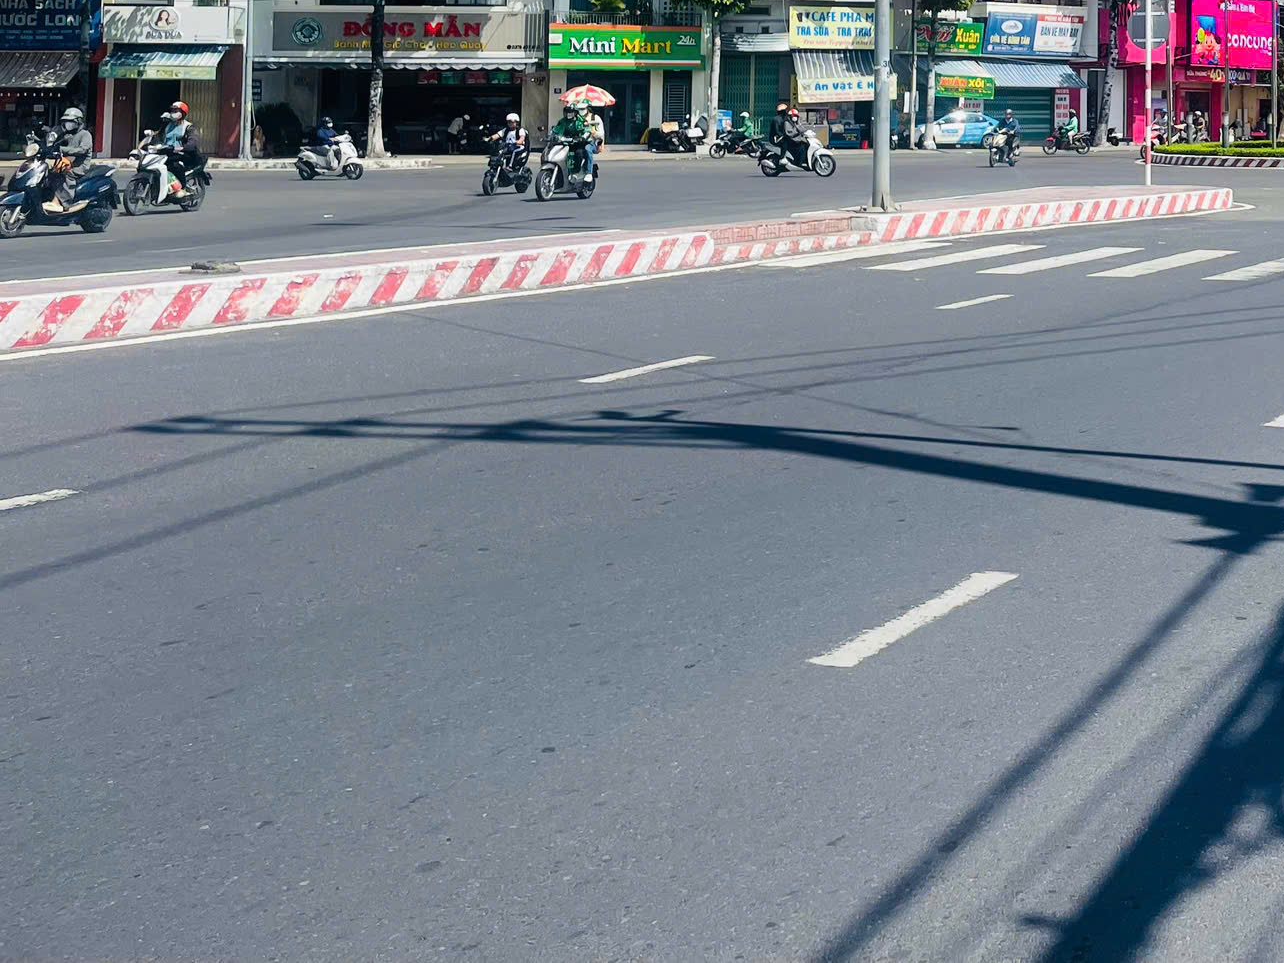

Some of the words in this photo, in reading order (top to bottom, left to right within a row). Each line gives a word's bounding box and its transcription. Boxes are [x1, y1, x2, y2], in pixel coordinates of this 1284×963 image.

[44, 14, 82, 26] LON
[840, 12, 862, 22] PHA
[677, 35, 696, 46] 24h
[956, 29, 980, 43] Xuân
[570, 36, 616, 54] Mini
[622, 38, 672, 54] Mart
